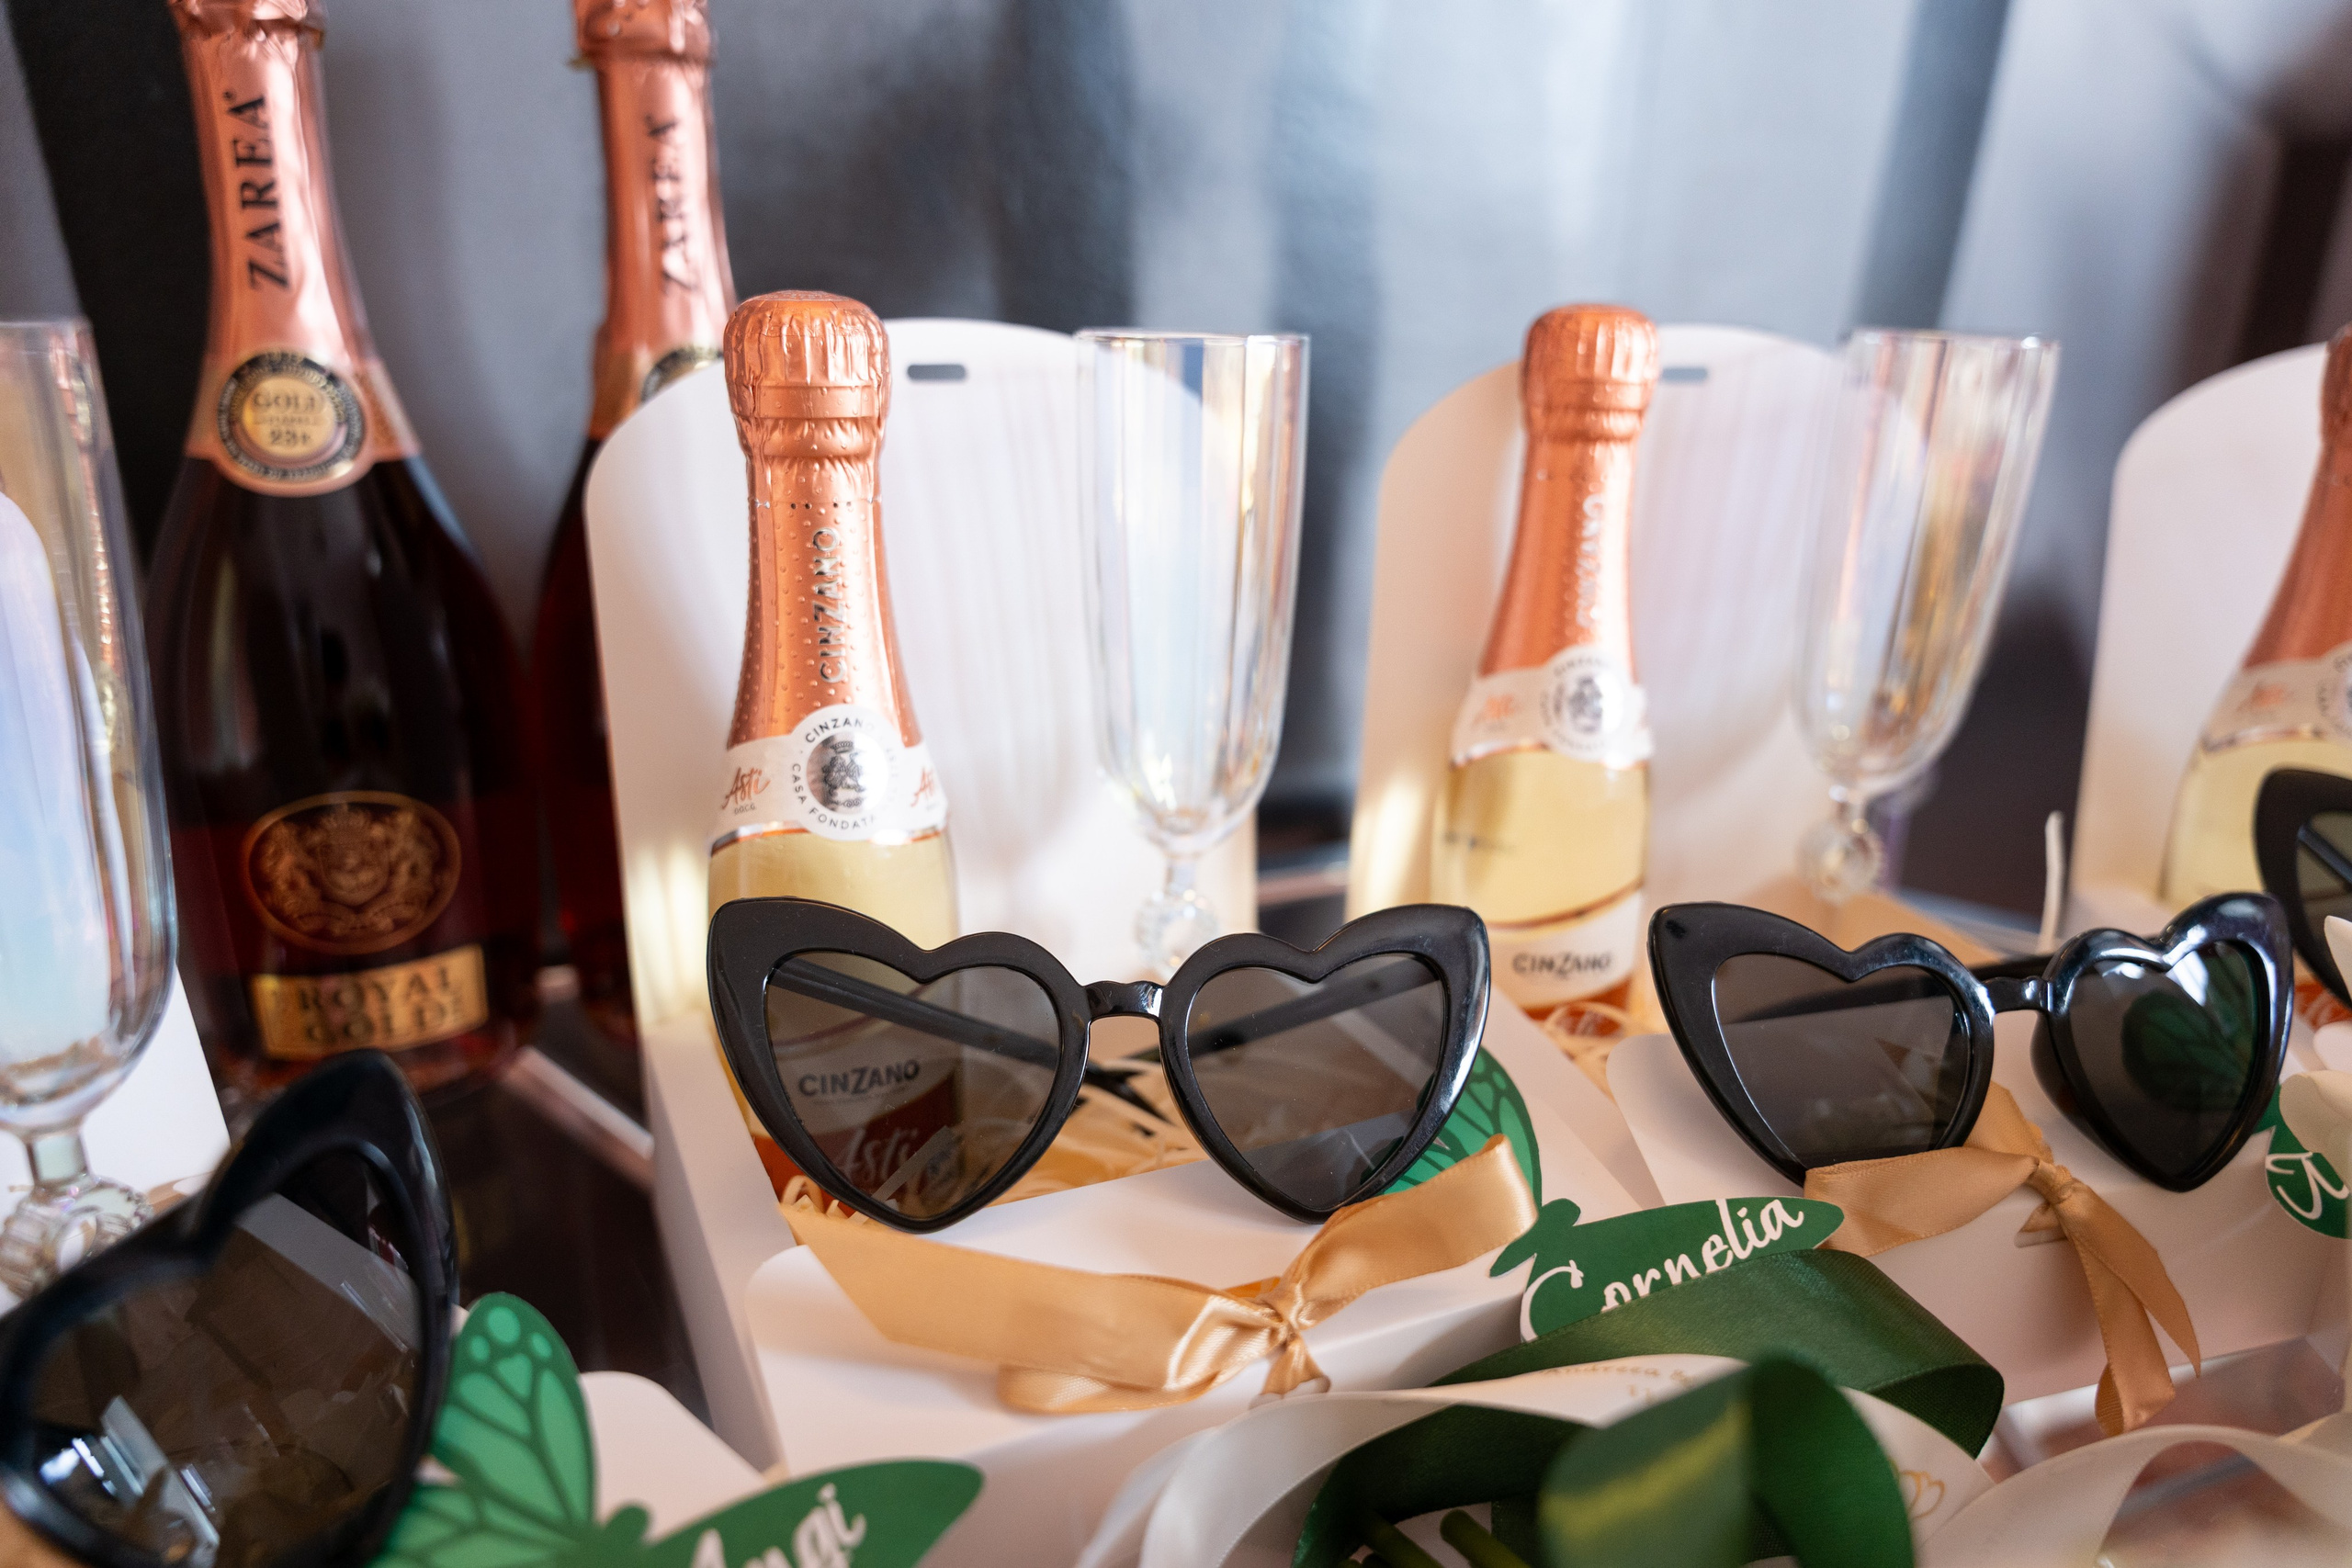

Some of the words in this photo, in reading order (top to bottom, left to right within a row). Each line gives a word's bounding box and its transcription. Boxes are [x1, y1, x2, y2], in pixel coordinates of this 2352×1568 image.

[226, 95, 291, 289] ZAREA
[812, 527, 847, 683] CINZANO
[721, 766, 772, 810] Asti
[792, 763, 808, 806] CASA
[1513, 953, 1611, 979] CINZANO
[798, 1059, 920, 1097] CINZANO
[1520, 1198, 1804, 1344] Cornelia
